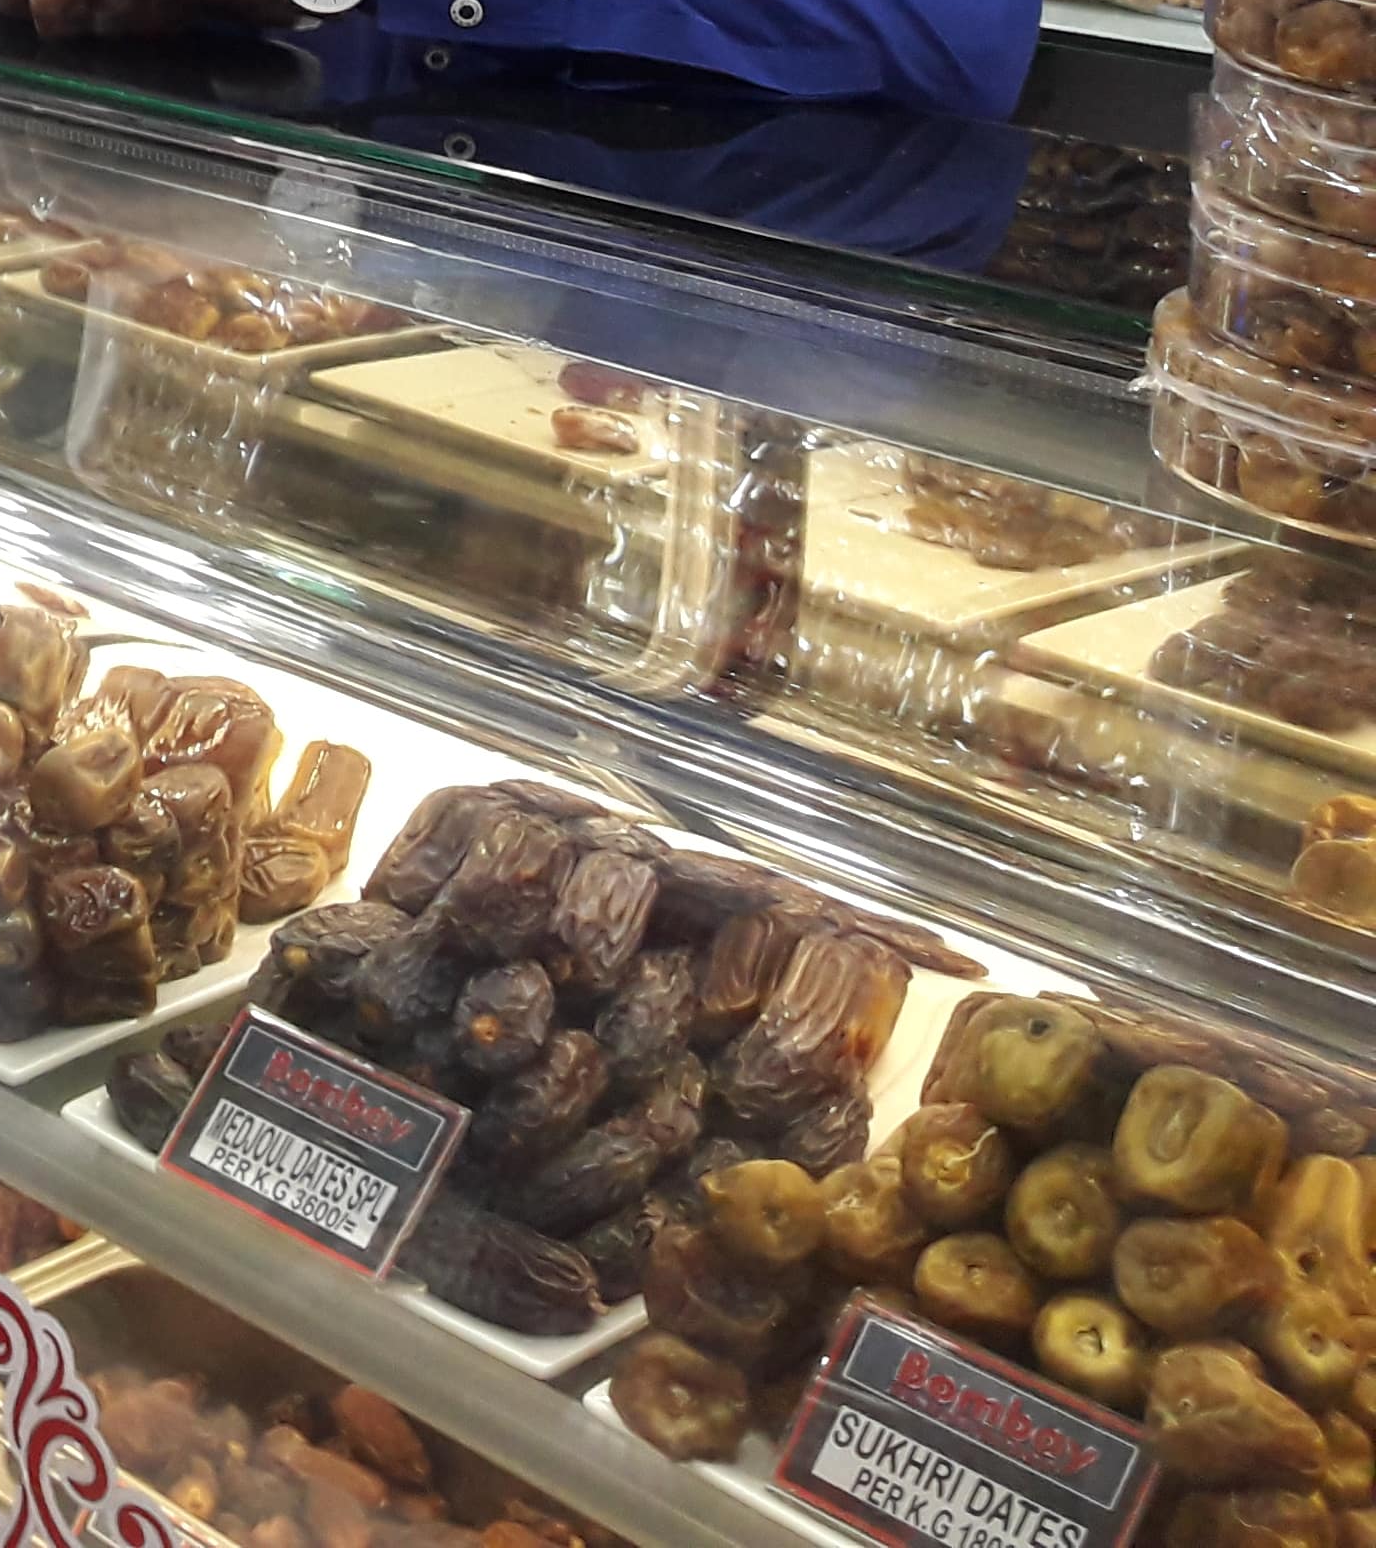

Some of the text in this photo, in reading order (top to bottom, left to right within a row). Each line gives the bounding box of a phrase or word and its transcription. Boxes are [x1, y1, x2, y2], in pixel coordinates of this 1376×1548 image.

[209, 1148, 252, 1180] PER
[293, 1144, 355, 1205] DATES
[349, 1172, 391, 1223] SPL
[893, 1349, 1101, 1477] Bombay
[831, 1413, 1084, 1548] SUKHRI DATES
[851, 1467, 902, 1510] PER
